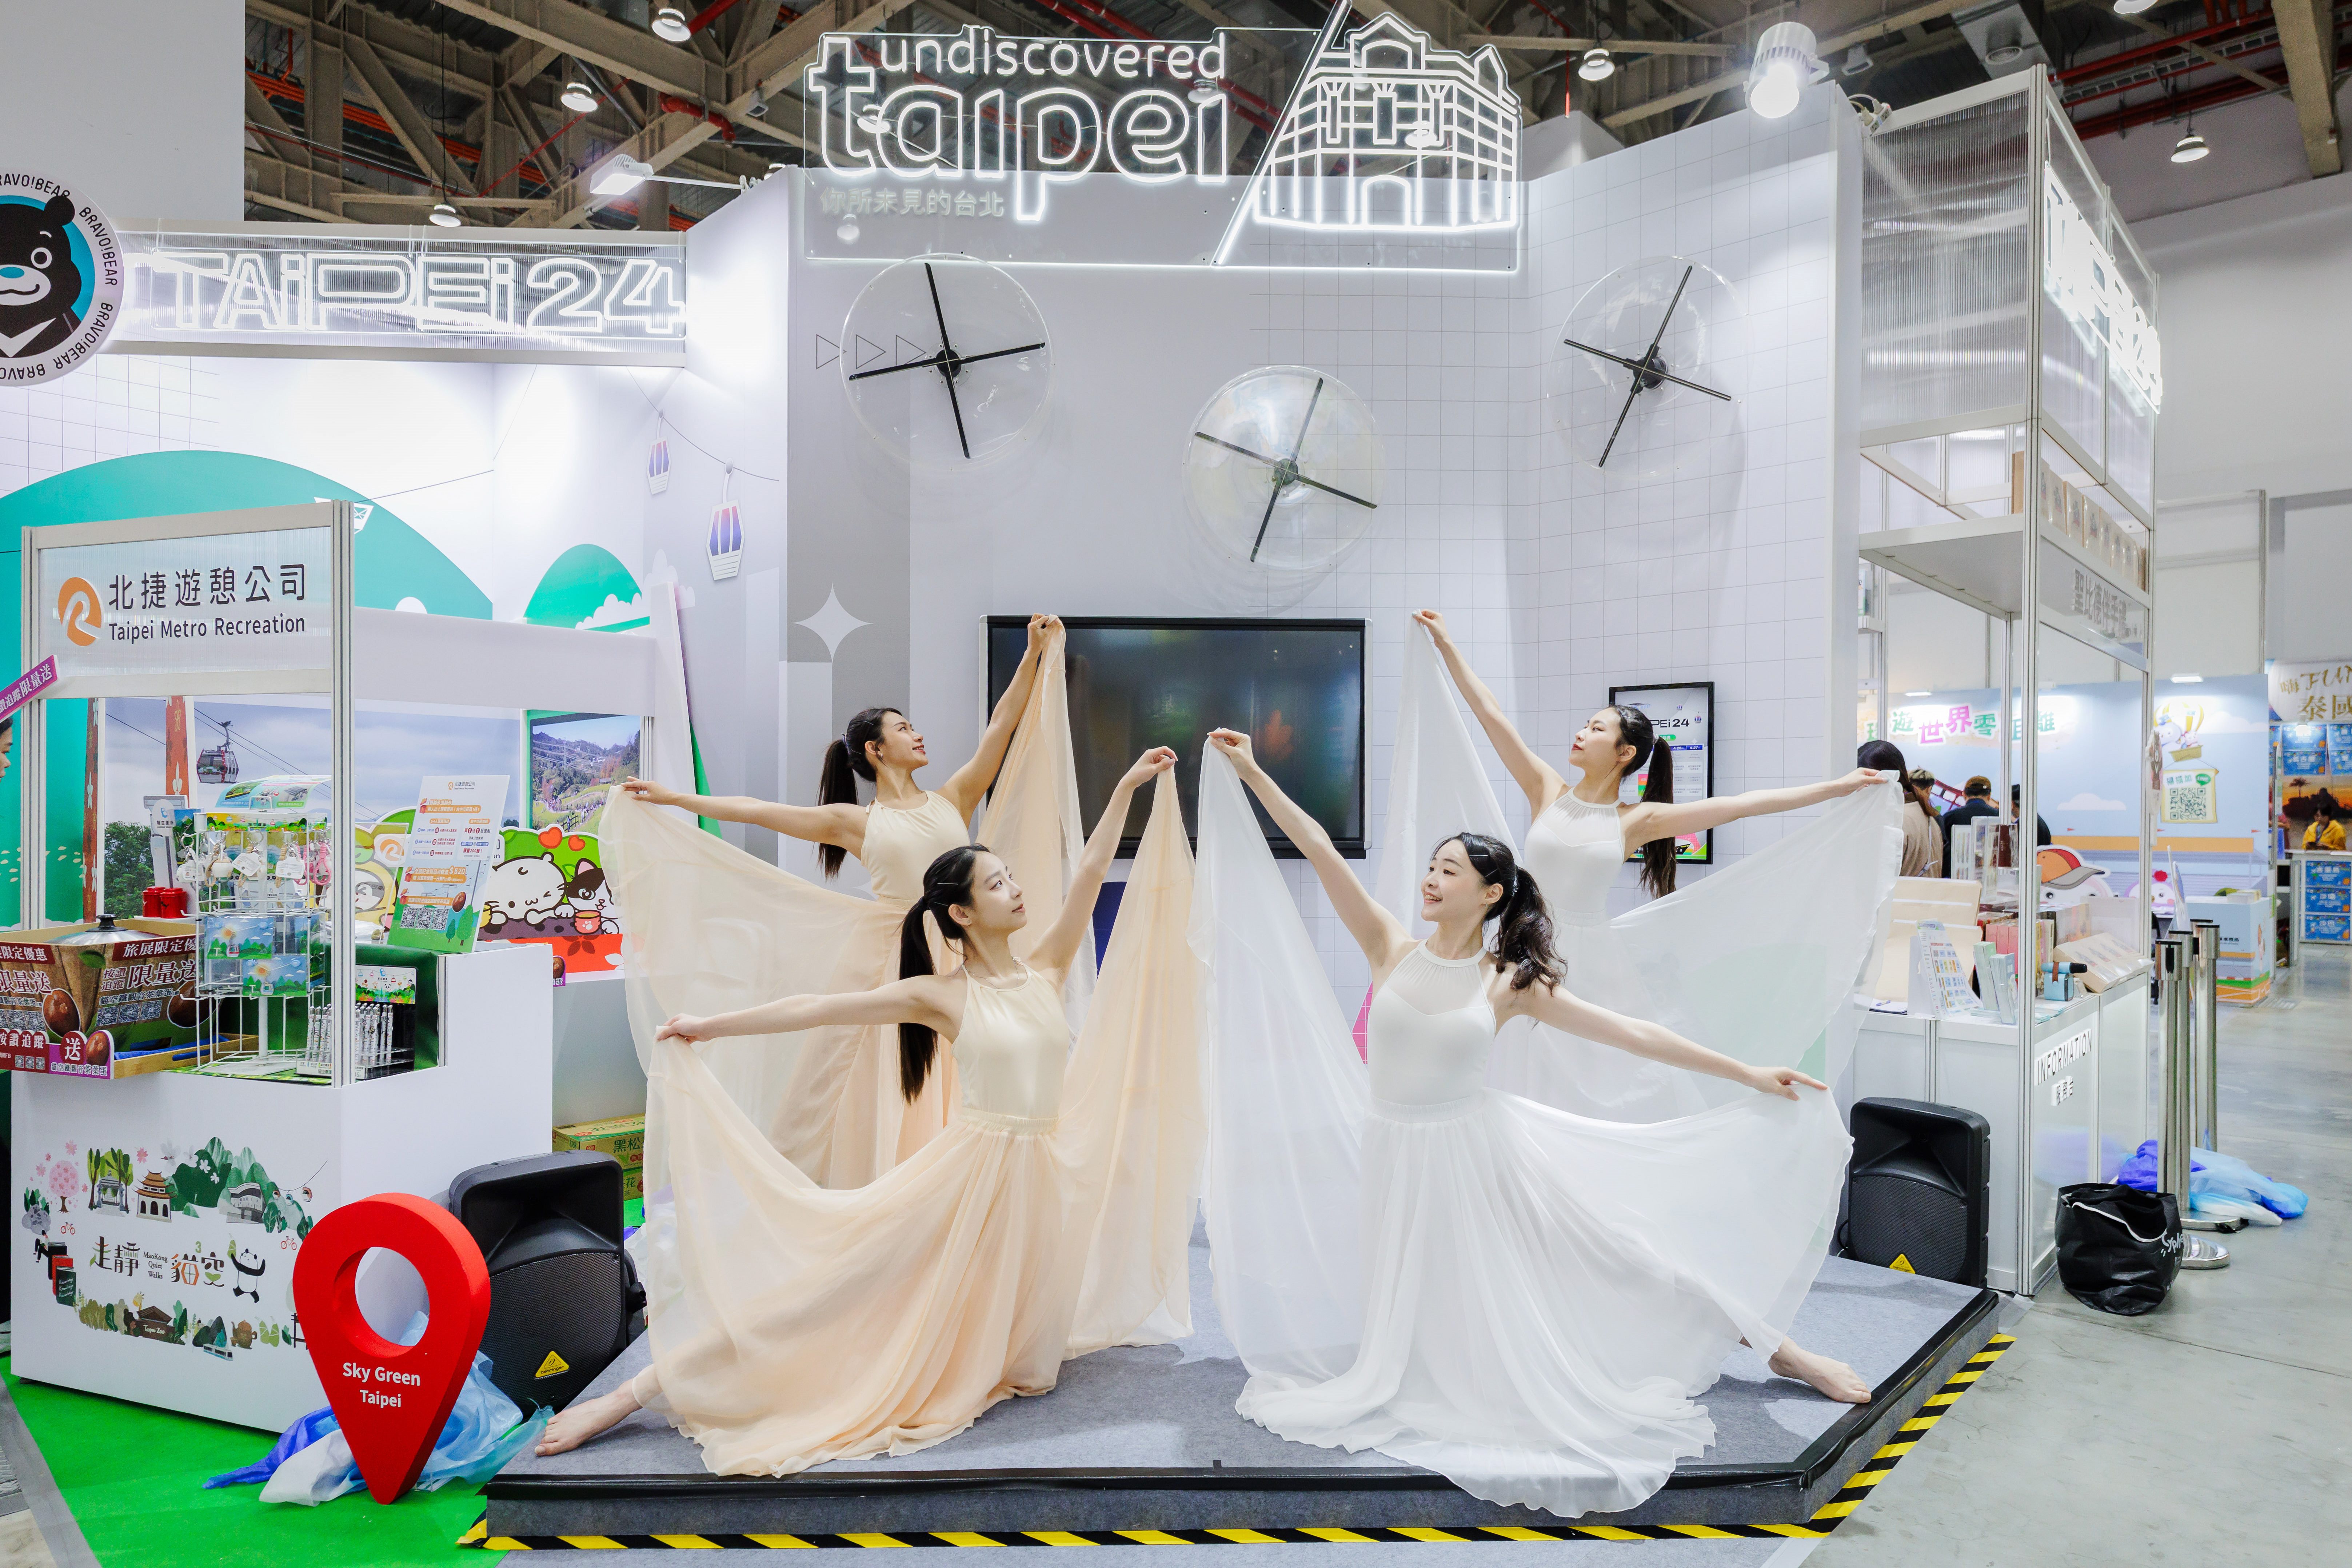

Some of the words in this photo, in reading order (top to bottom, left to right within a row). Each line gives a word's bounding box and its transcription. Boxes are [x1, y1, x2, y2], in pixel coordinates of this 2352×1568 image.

[881, 27, 1225, 79] undiscovered
[809, 37, 1227, 221] taipei
[820, 187, 1004, 217] 你所未見的台北
[79, 207, 118, 286] BRAVO!BEAR
[53, 302, 113, 370] BRAVO!BEAR
[108, 564, 306, 611] 北捷遊憩公司
[109, 620, 153, 645] Taipei
[161, 618, 207, 639] Metro
[215, 613, 305, 635] Recreation
[2297, 695, 2352, 721] 泰國
[100, 979, 125, 992] 追蹤
[127, 960, 196, 989] 限量送
[64, 1037, 81, 1061] 送
[2034, 1029, 2092, 1086] INFORMATION
[143, 1251, 168, 1263] MaoKong
[148, 1261, 163, 1269] Quiet
[148, 1271, 163, 1279] Walks
[143, 1324, 156, 1334] Taipei
[342, 1361, 371, 1383] Sky
[374, 1366, 420, 1386] Green
[540, 1365, 564, 1374] behringer
[359, 1389, 402, 1409] Taipei
